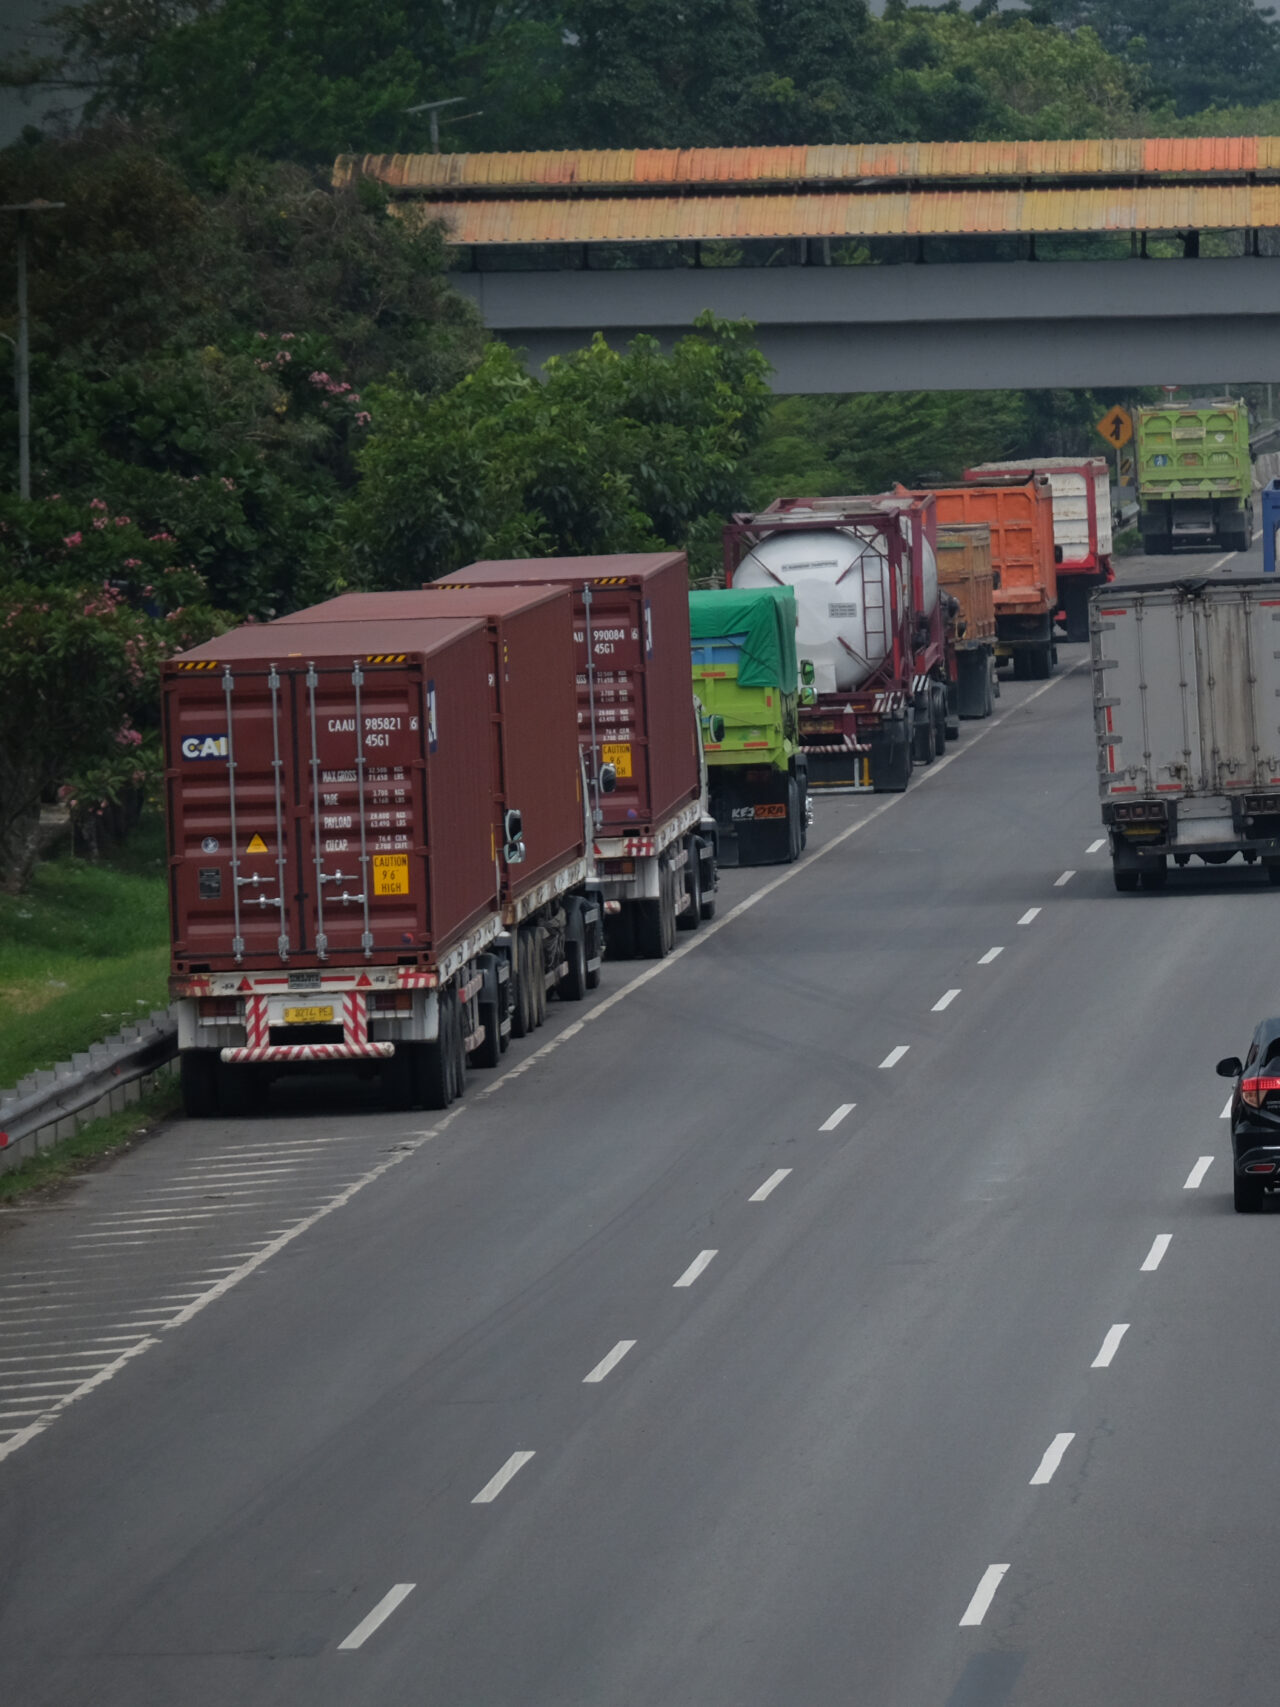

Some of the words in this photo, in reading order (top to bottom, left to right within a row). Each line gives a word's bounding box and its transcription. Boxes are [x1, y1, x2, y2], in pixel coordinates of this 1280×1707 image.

[594, 629, 624, 641] 990084
[594, 643, 614, 654] 45G1
[328, 720, 356, 732] CAAU
[365, 718, 401, 730] 985821
[365, 734, 390, 746] 45G1
[182, 736, 228, 758] CAI
[603, 746, 630, 754] CAUTION
[616, 767, 626, 776] GH
[324, 816, 352, 828] PAYLOAD
[374, 856, 406, 867] CAUTION
[382, 883, 402, 892] HIGH
